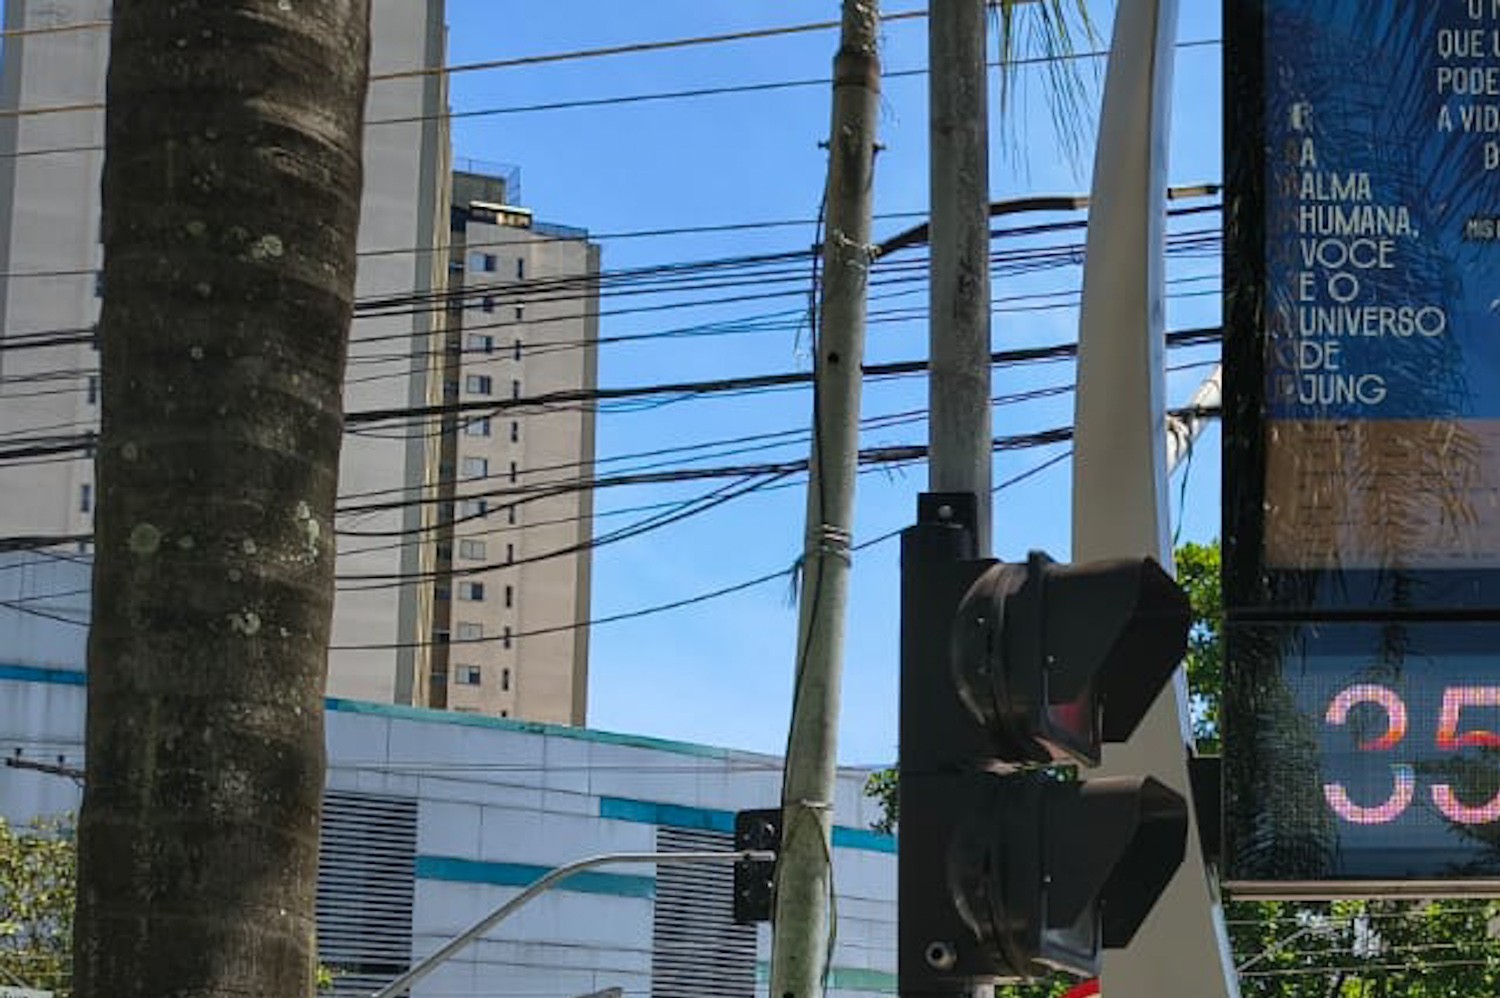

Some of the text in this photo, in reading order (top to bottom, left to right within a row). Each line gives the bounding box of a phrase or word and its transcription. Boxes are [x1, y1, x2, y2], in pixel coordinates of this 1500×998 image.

[1437, 29, 1485, 59] QUE
[1437, 67, 1500, 96] PODE
[1438, 105, 1453, 133] A
[1300, 137, 1316, 168] A
[1300, 171, 1373, 201] ALMA
[1327, 271, 1360, 304] O
[1300, 305, 1447, 337] UNIVERSO
[1300, 339, 1341, 371] DE
[1299, 373, 1388, 405] JUNG
